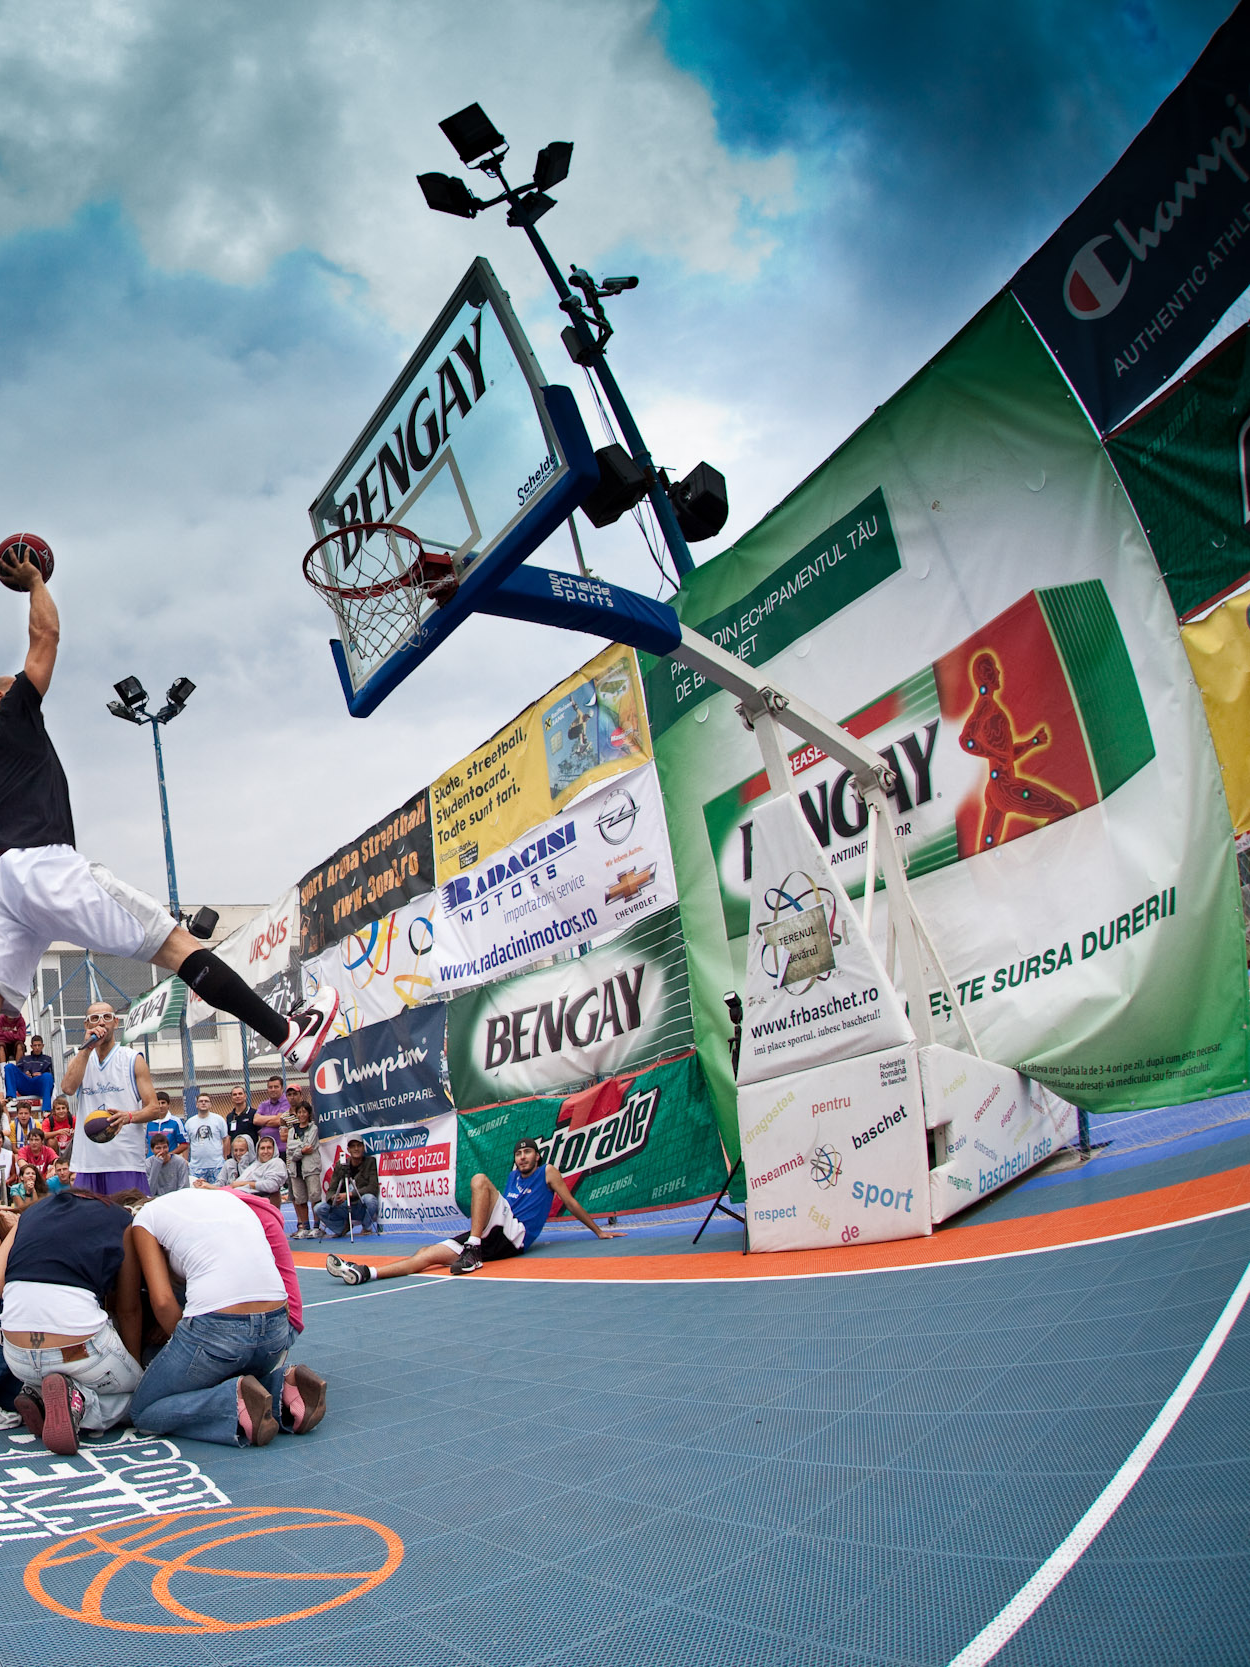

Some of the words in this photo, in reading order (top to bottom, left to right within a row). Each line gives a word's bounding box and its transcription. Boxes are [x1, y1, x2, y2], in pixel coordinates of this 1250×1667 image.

[1113, 265, 1208, 377] AUTHENTIC
[337, 311, 487, 572] BENGAY
[517, 453, 556, 506] Schelde
[548, 572, 612, 597] Schelde
[552, 585, 614, 608] Sports
[712, 623, 738, 648] DIN
[740, 544, 847, 634] ECHIPAMENTUL
[847, 515, 879, 551] TĂU
[676, 677, 692, 703] DE
[435, 776, 464, 804] Skate,
[467, 727, 527, 780] streetball,
[437, 763, 510, 825] Studentocard.
[438, 819, 466, 845] Toate
[470, 799, 493, 826] sunt
[497, 778, 521, 806] tari.
[443, 820, 577, 913] RADACINI
[301, 872, 324, 907] Sport
[461, 864, 557, 924] MOTORS
[503, 894, 550, 924] importator
[557, 875, 585, 899] service
[615, 894, 658, 920] CHEVROLET
[249, 916, 288, 965] URSUS
[440, 908, 598, 982] www.radacinimotors.ro
[778, 926, 817, 946] TERENUL
[788, 945, 819, 964] devărul
[991, 942, 1073, 992] SURSA
[1081, 886, 1176, 960] DURERII
[484, 963, 645, 1070] BENGAY
[751, 987, 878, 1039] www.frbaschet.ro
[767, 1039, 787, 1054] place
[818, 1024, 841, 1038] iubesc
[842, 1009, 881, 1030] baschetul!
[1049, 1066, 1059, 1074] ore
[1080, 1066, 1087, 1075] la
[1088, 1065, 1098, 1075] de
[1099, 1065, 1111, 1075] 3-4
[1112, 1062, 1123, 1073] ori
[1123, 1063, 1133, 1073] pe
[1146, 1056, 1164, 1068] după
[1166, 1055, 1180, 1064] cum
[1182, 1050, 1195, 1060] este
[1196, 1043, 1222, 1057] necesar.
[1116, 1073, 1151, 1087] medicului
[1152, 1071, 1164, 1081] sau
[1165, 1061, 1211, 1079] farmacistului.
[398, 1088, 436, 1105] APPAREL
[811, 1096, 851, 1118] pentru
[974, 1084, 1001, 1123] spectaculos
[467, 1113, 511, 1138] REHYDRATE
[744, 1090, 796, 1145] dragostea
[851, 1104, 908, 1149] baschet
[401, 1132, 428, 1149] lume
[405, 1151, 416, 1169] de
[418, 1149, 446, 1172] pizza.
[750, 1153, 805, 1190] înseamnă
[978, 1143, 1031, 1194] baschetul
[1032, 1136, 1052, 1162] este
[589, 1174, 634, 1201] REPLENISH
[651, 1175, 687, 1199] REFUEL
[851, 1181, 913, 1213] sport
[947, 1174, 973, 1192] magnific
[754, 1205, 797, 1222] respect
[841, 1225, 860, 1243] de
